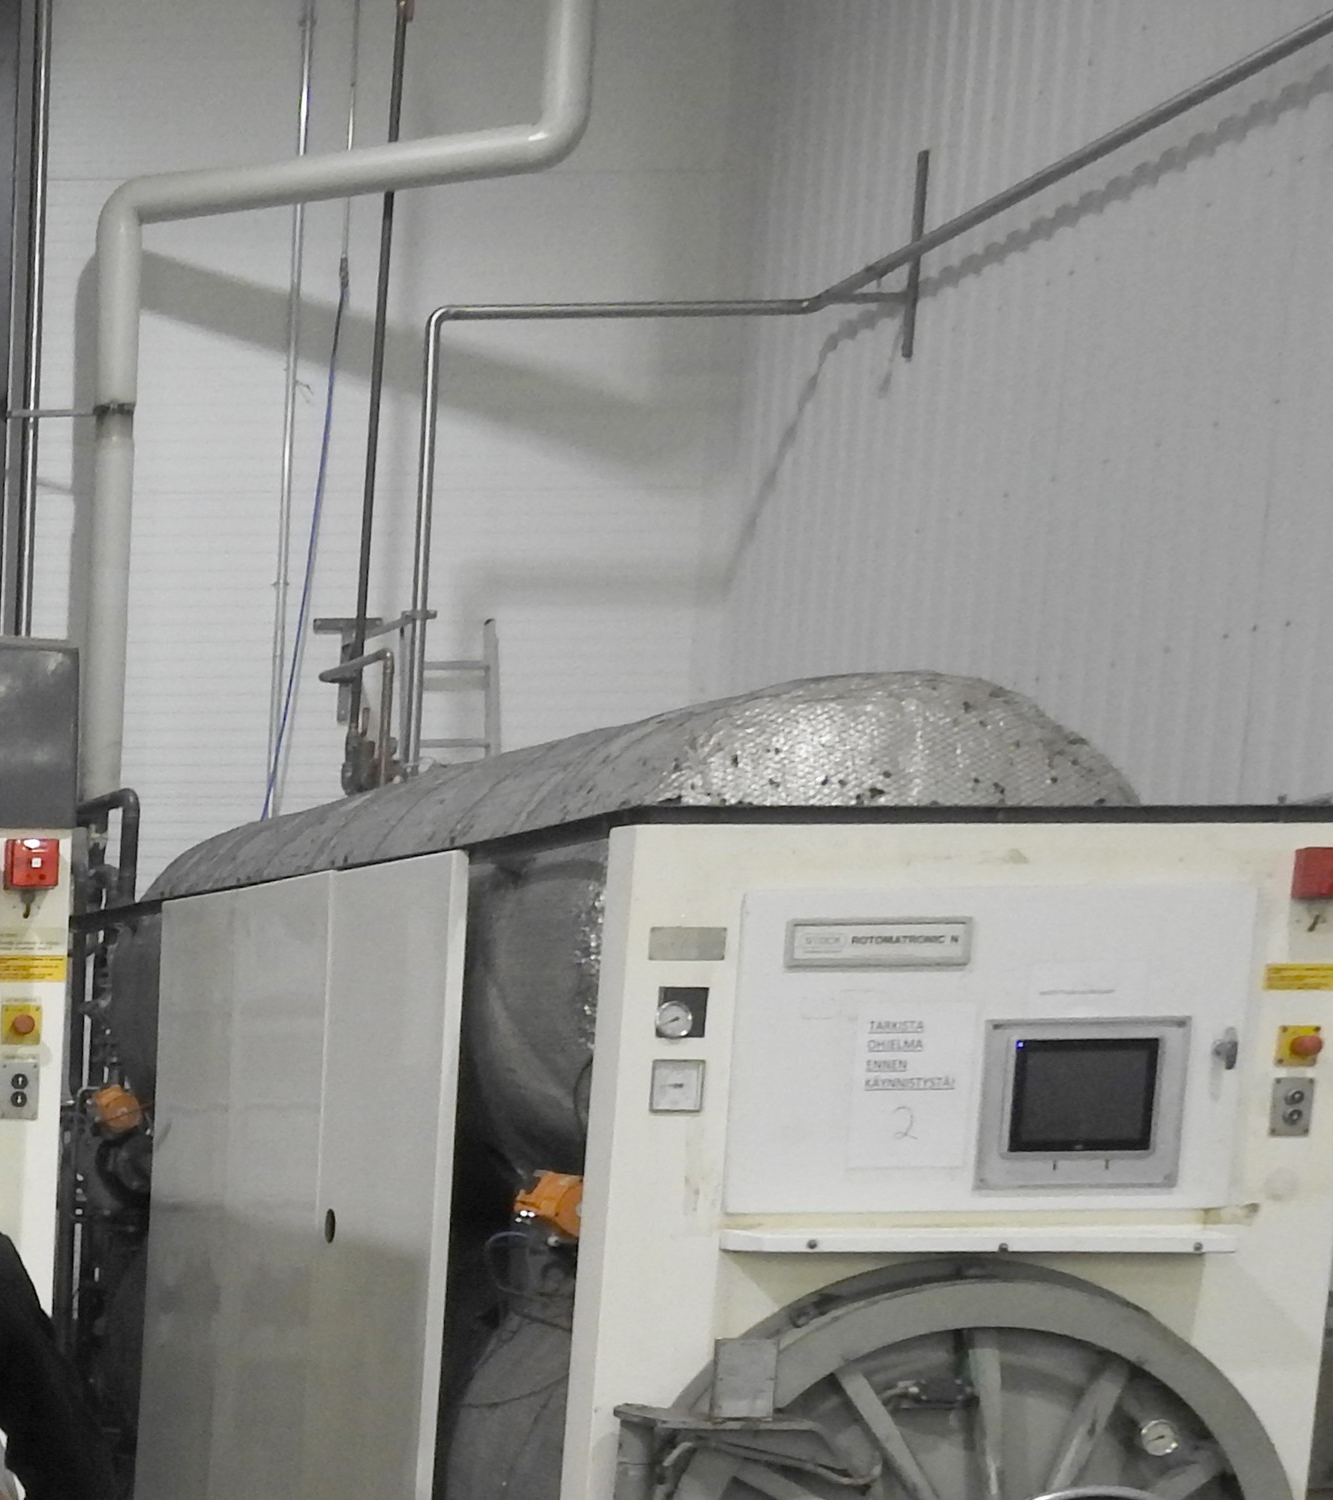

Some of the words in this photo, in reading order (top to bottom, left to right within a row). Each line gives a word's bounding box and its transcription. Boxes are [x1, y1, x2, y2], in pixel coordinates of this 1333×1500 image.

[851, 934, 946, 945] ROTOMATRONIC
[869, 1020, 925, 1031] TARKISTA
[867, 1039, 924, 1050] OHJELMA
[866, 1059, 908, 1070] ENNEN
[891, 1105, 918, 1140] 2
